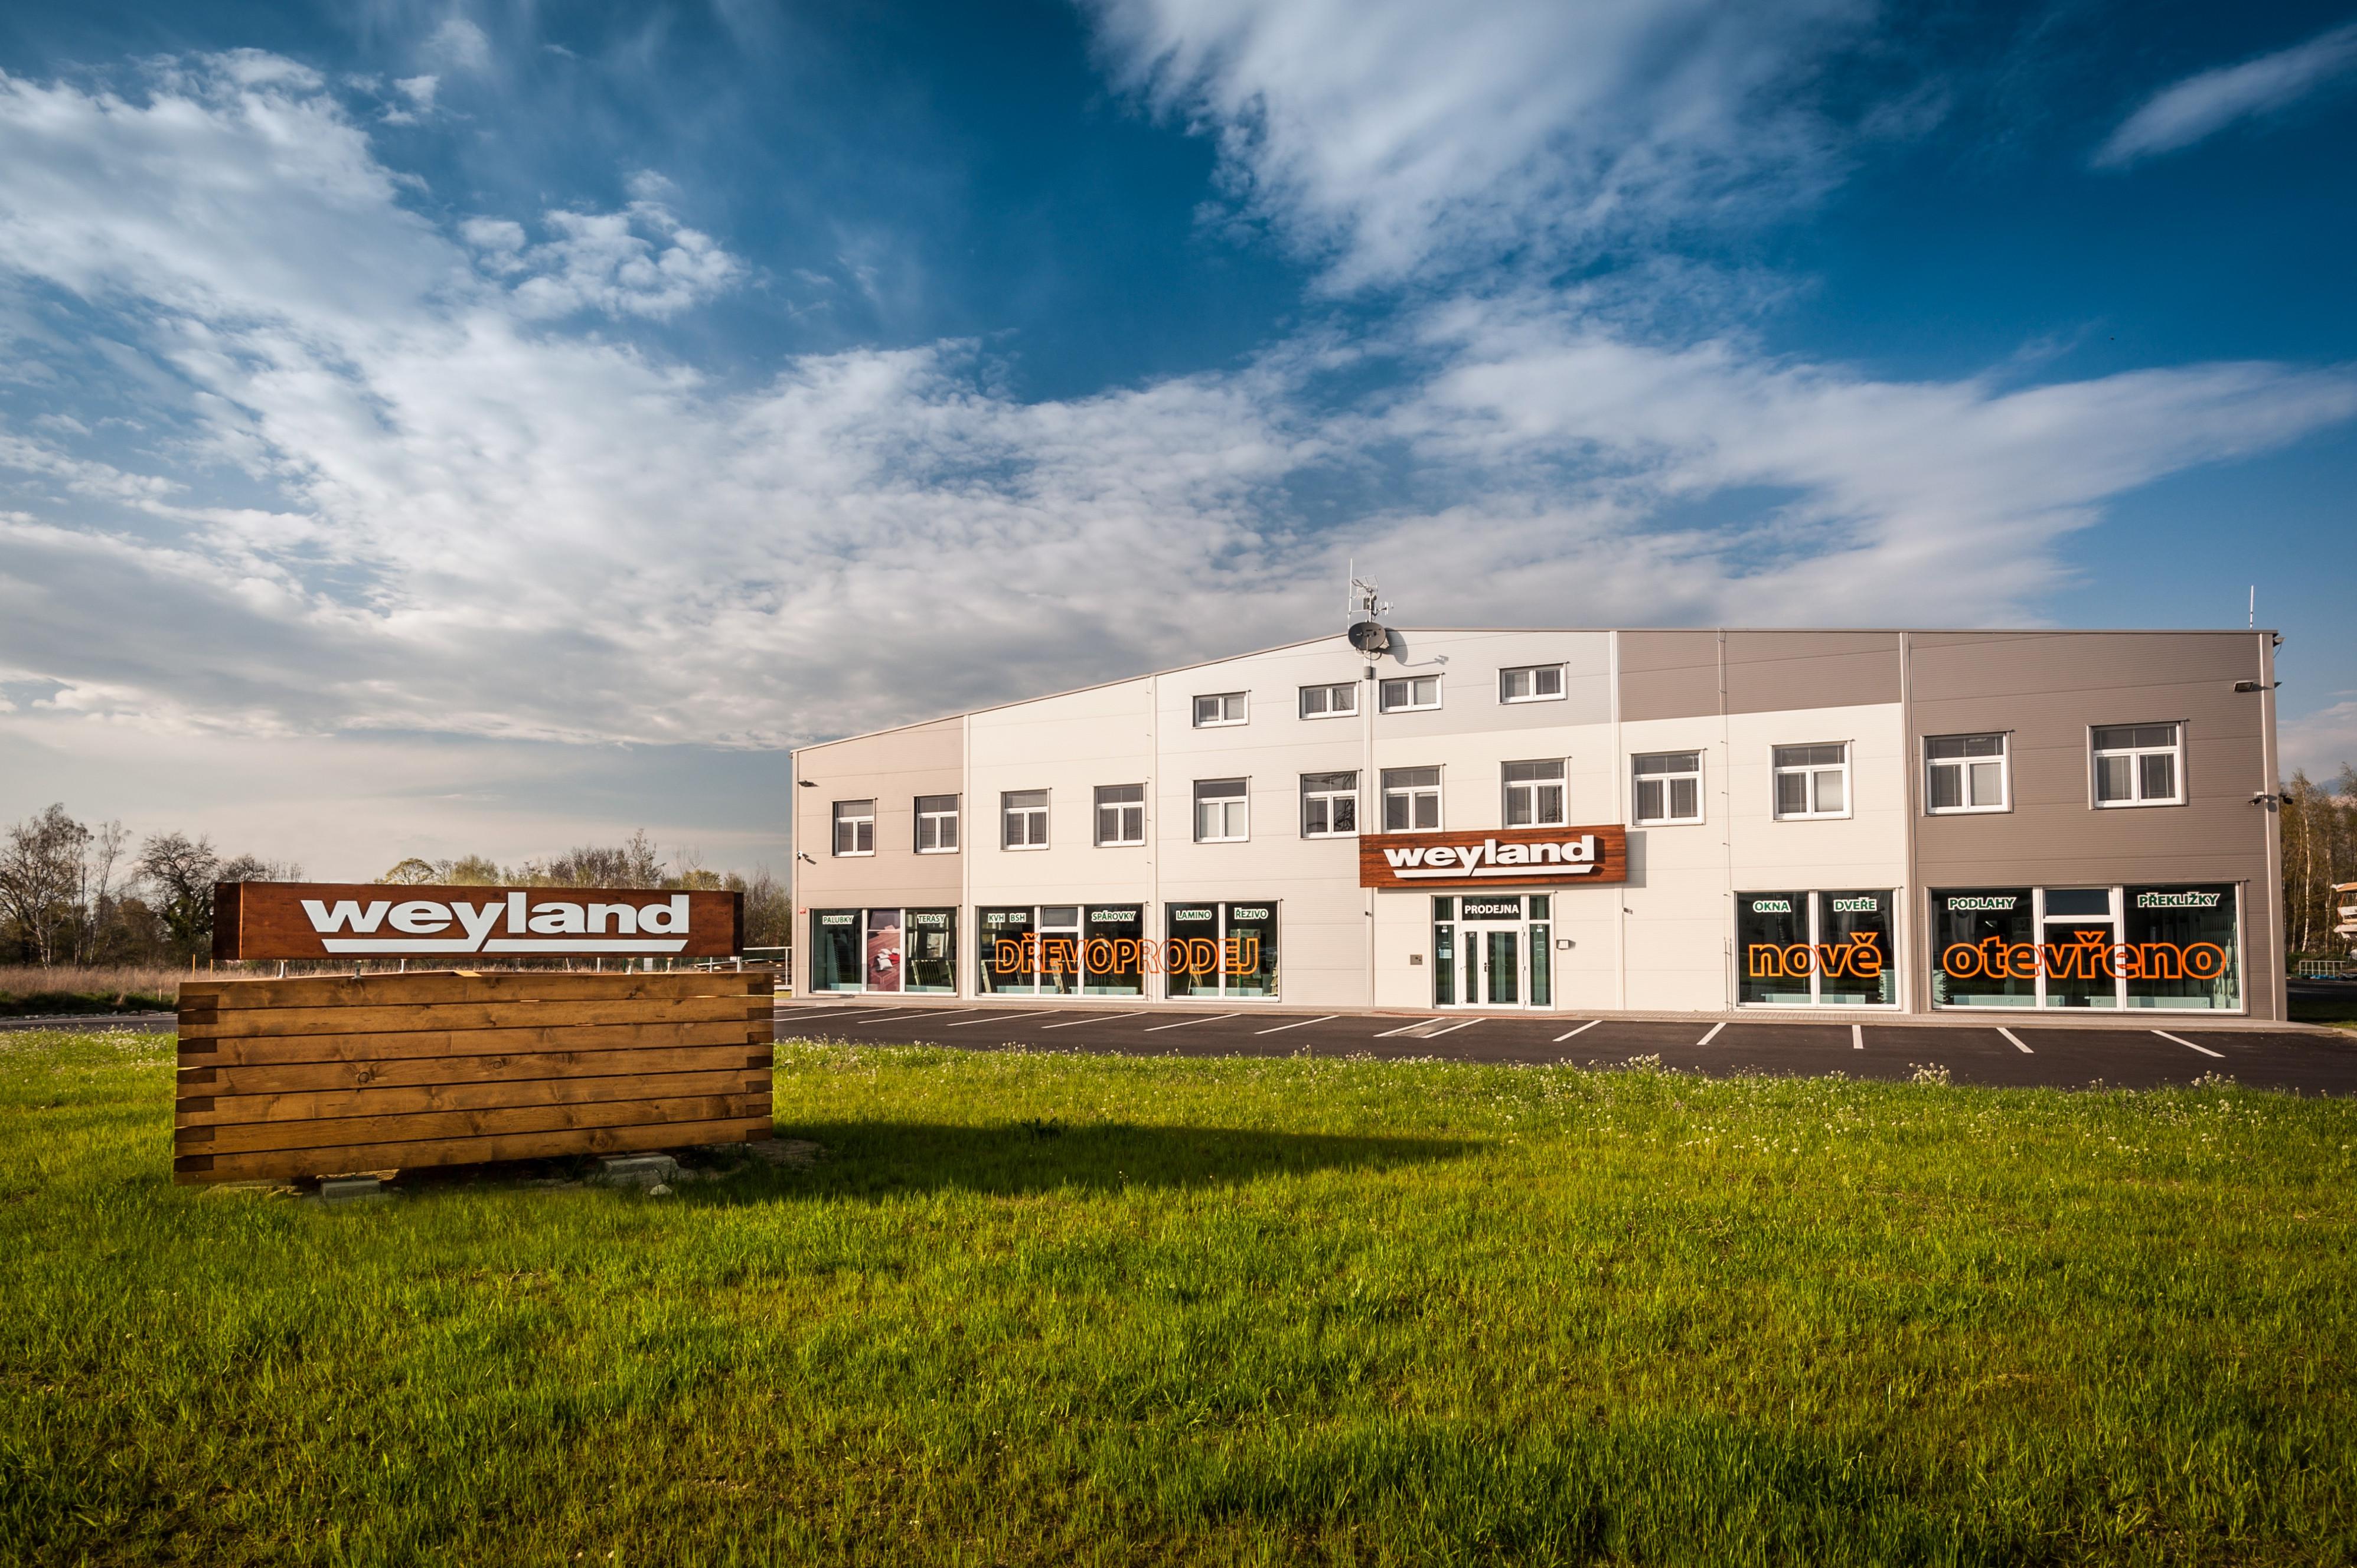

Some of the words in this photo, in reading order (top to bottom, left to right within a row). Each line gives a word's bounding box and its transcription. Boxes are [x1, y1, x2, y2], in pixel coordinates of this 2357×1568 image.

[1383, 835, 1594, 877] weyland
[1834, 898, 1876, 910] DVEŘE
[1948, 897, 2015, 909] PODLAHY
[2139, 893, 2218, 907] PŘEKLIŽKY
[1464, 904, 1519, 914] PRODEJNA
[1754, 901, 1790, 912] OKNA
[918, 914, 946, 923] TERASY
[988, 914, 1005, 923] KVH
[1010, 914, 1026, 922] BSH
[1092, 910, 1135, 922] SPÁROVKY
[1176, 910, 1212, 920] LAMINO
[1235, 907, 1268, 919] ŘEZIVO
[301, 892, 689, 952] weyland
[822, 916, 854, 924] PALUBKY
[995, 933, 1259, 975] DŘEVOPRODEJ
[1749, 932, 1882, 978] nově
[1943, 931, 2226, 980] otevřeno
